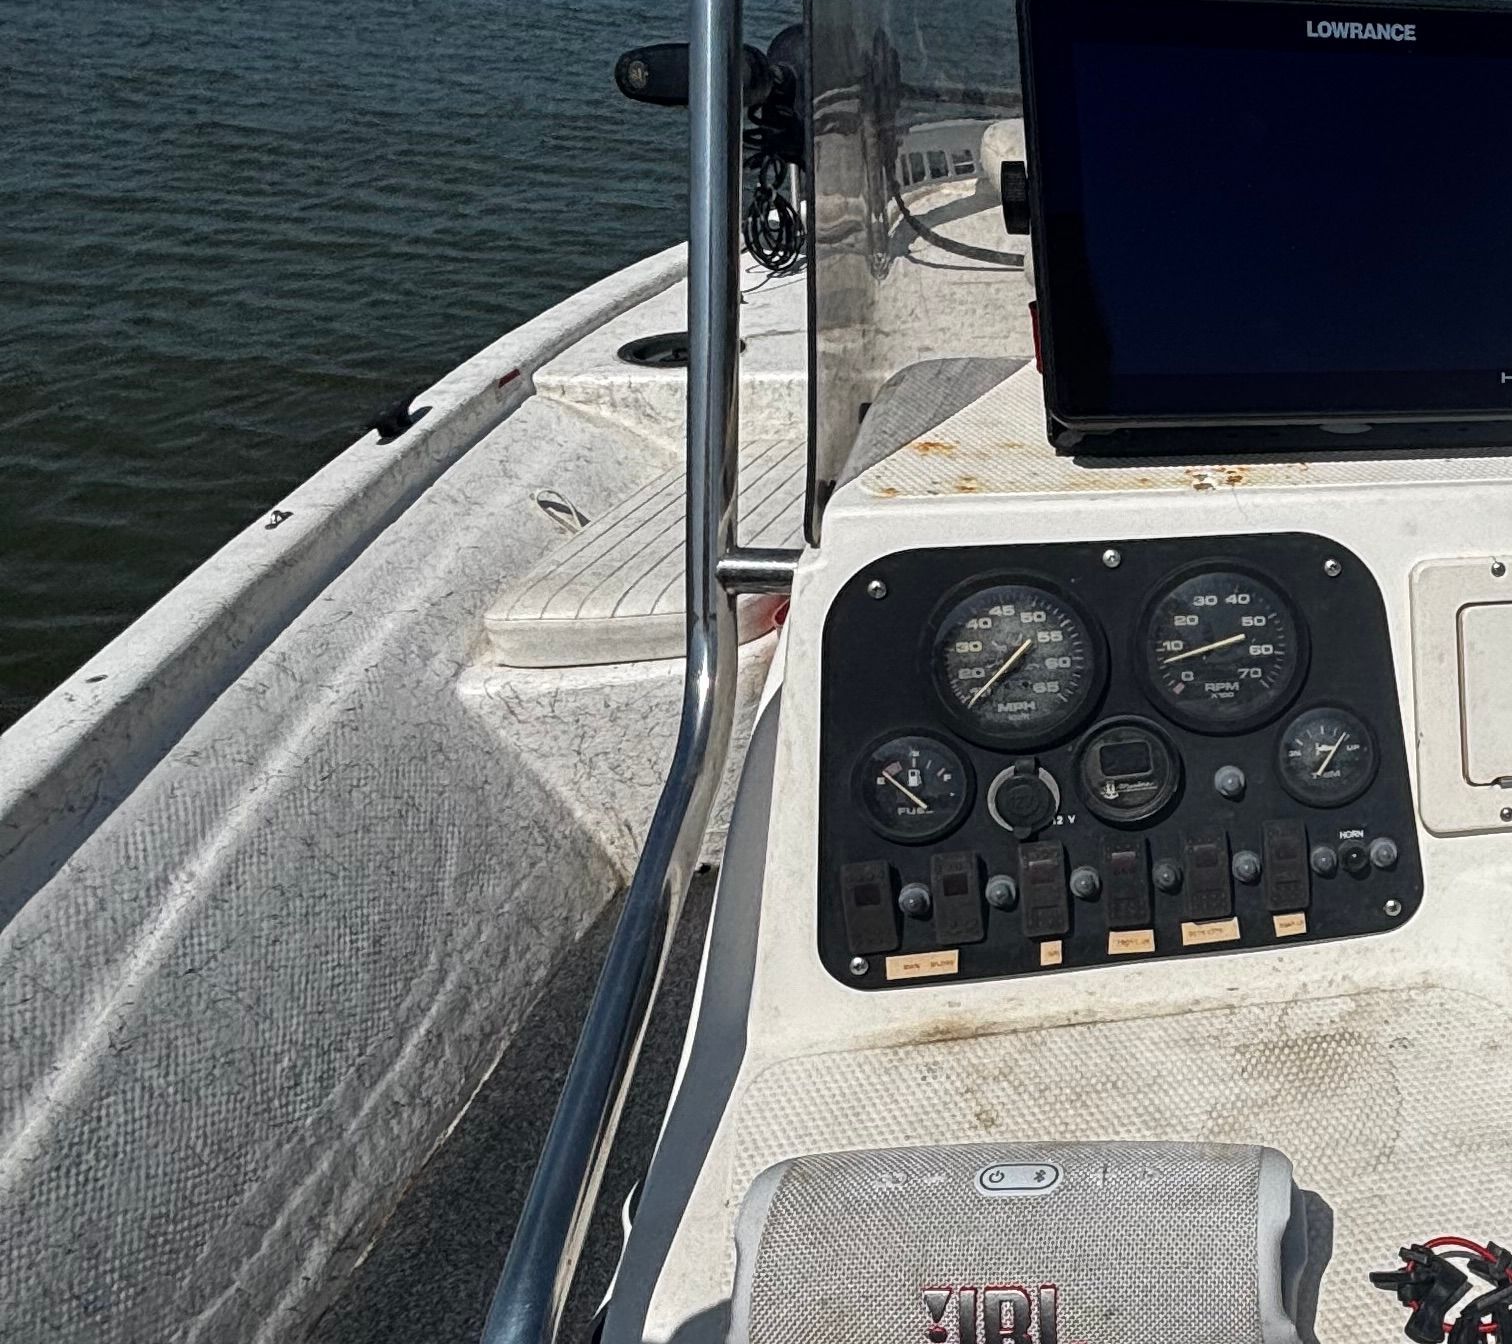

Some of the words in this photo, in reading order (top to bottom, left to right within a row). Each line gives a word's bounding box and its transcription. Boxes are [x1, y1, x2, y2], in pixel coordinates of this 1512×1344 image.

[1306, 20, 1417, 41] LOWRANCE
[1193, 595, 1218, 606] 30
[1225, 594, 1250, 605] 40
[989, 605, 1015, 616] 45
[1020, 611, 1046, 623] 50
[1174, 615, 1199, 626] 20
[1241, 616, 1266, 627] 50
[966, 617, 992, 630] 40
[1037, 630, 1063, 643] 55
[956, 641, 983, 653] 30
[1163, 640, 1184, 651] 10
[1249, 644, 1274, 656] 60
[958, 667, 985, 679] 20
[1181, 671, 1194, 681] 0
[1238, 668, 1262, 679] 70
[1205, 682, 1240, 691] RPM
[998, 701, 1036, 712] MPH
[1068, 815, 1076, 823] V
[1339, 830, 1364, 840] HORN
